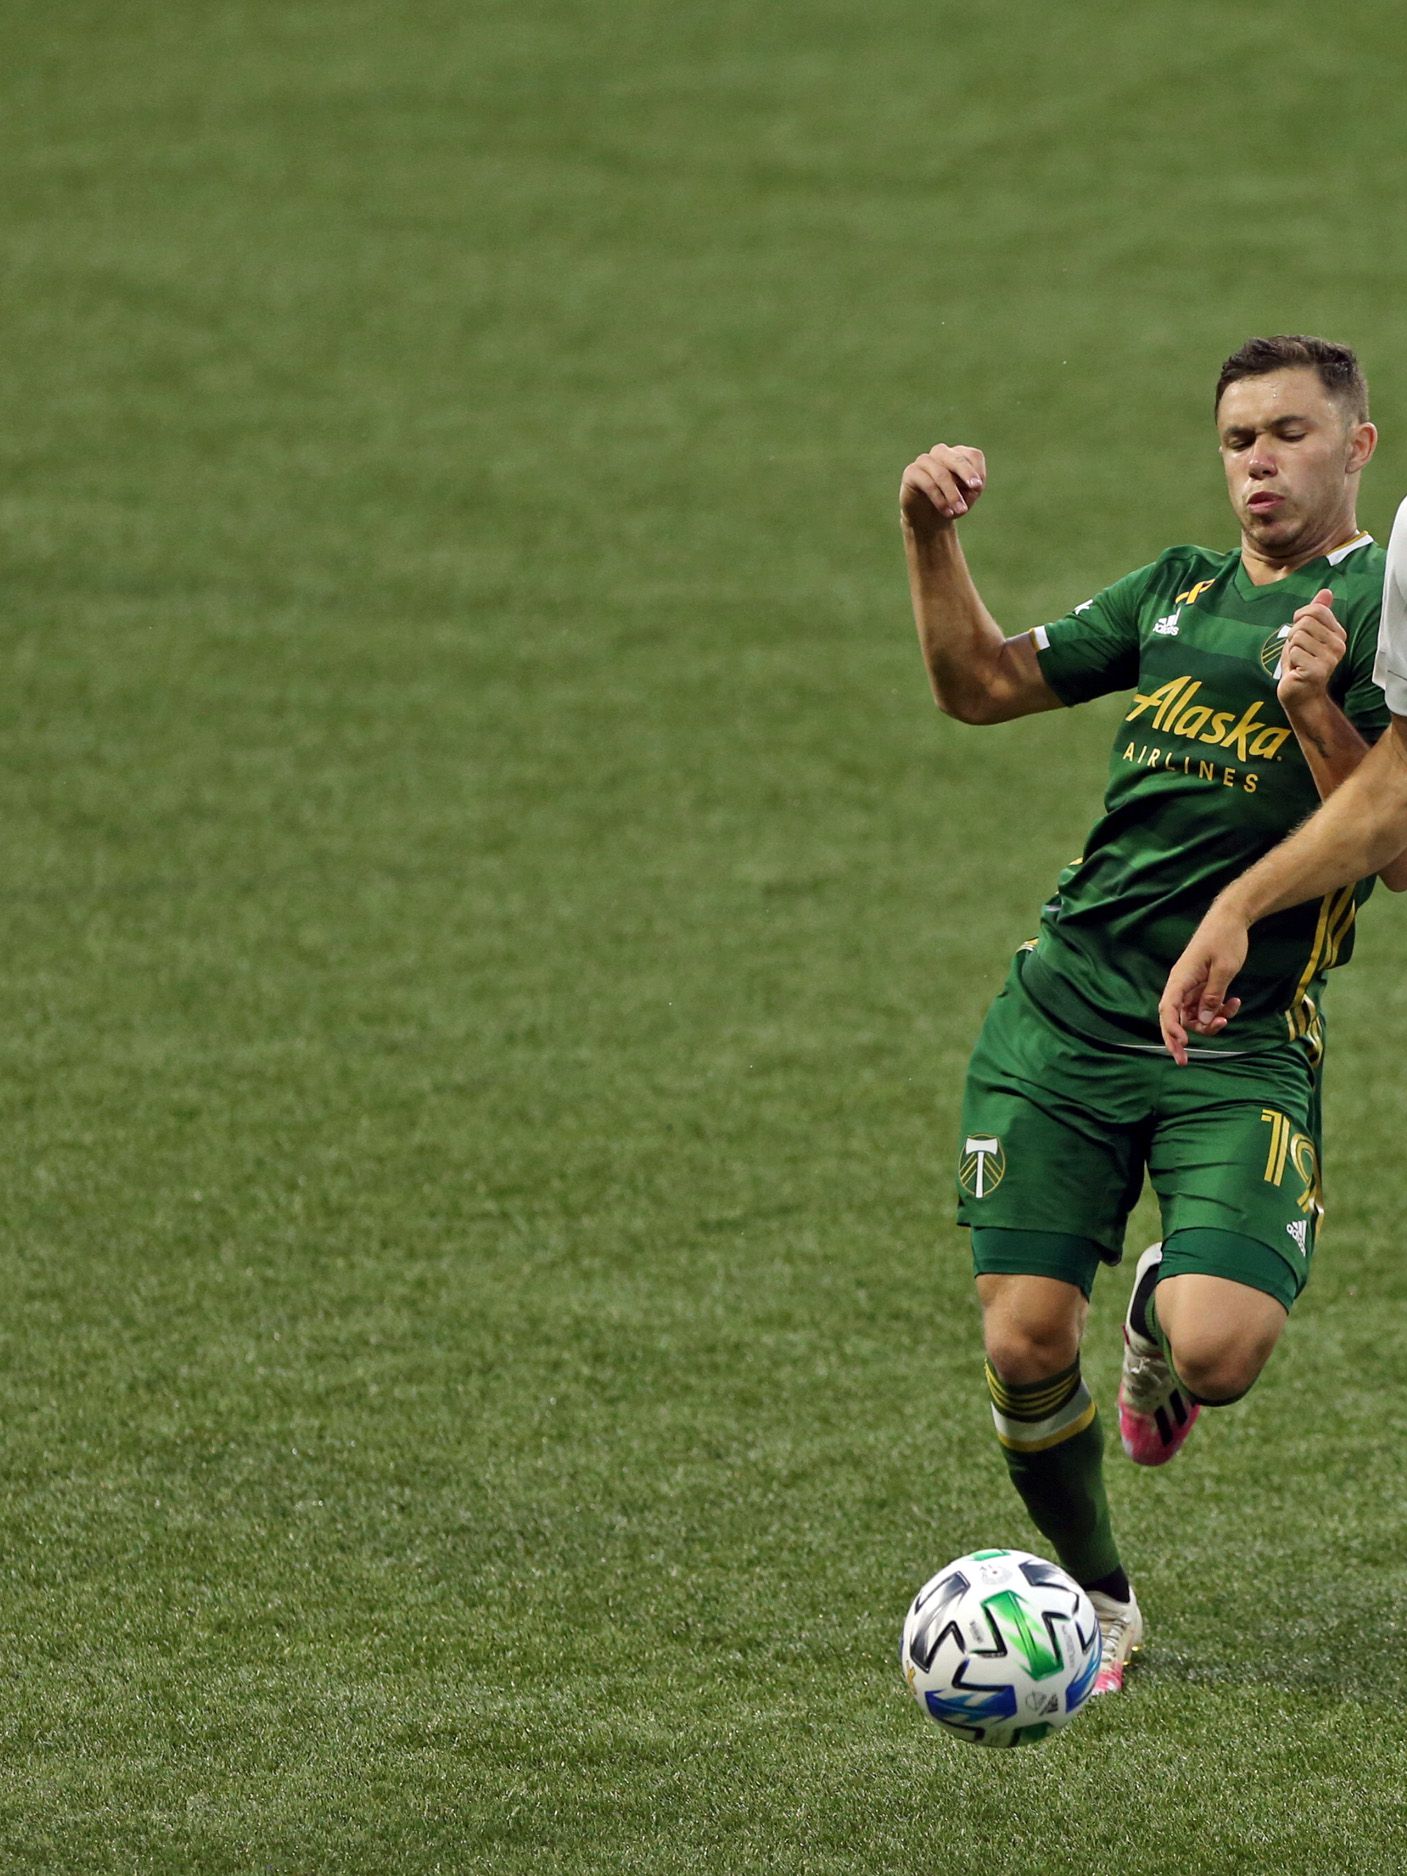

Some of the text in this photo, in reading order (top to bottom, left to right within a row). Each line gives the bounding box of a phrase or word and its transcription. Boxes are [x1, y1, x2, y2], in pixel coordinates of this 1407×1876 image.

[1124, 675, 1292, 763] Alaska
[1122, 742, 1259, 794] AIRLINES
[1260, 1108, 1323, 1213] 19
